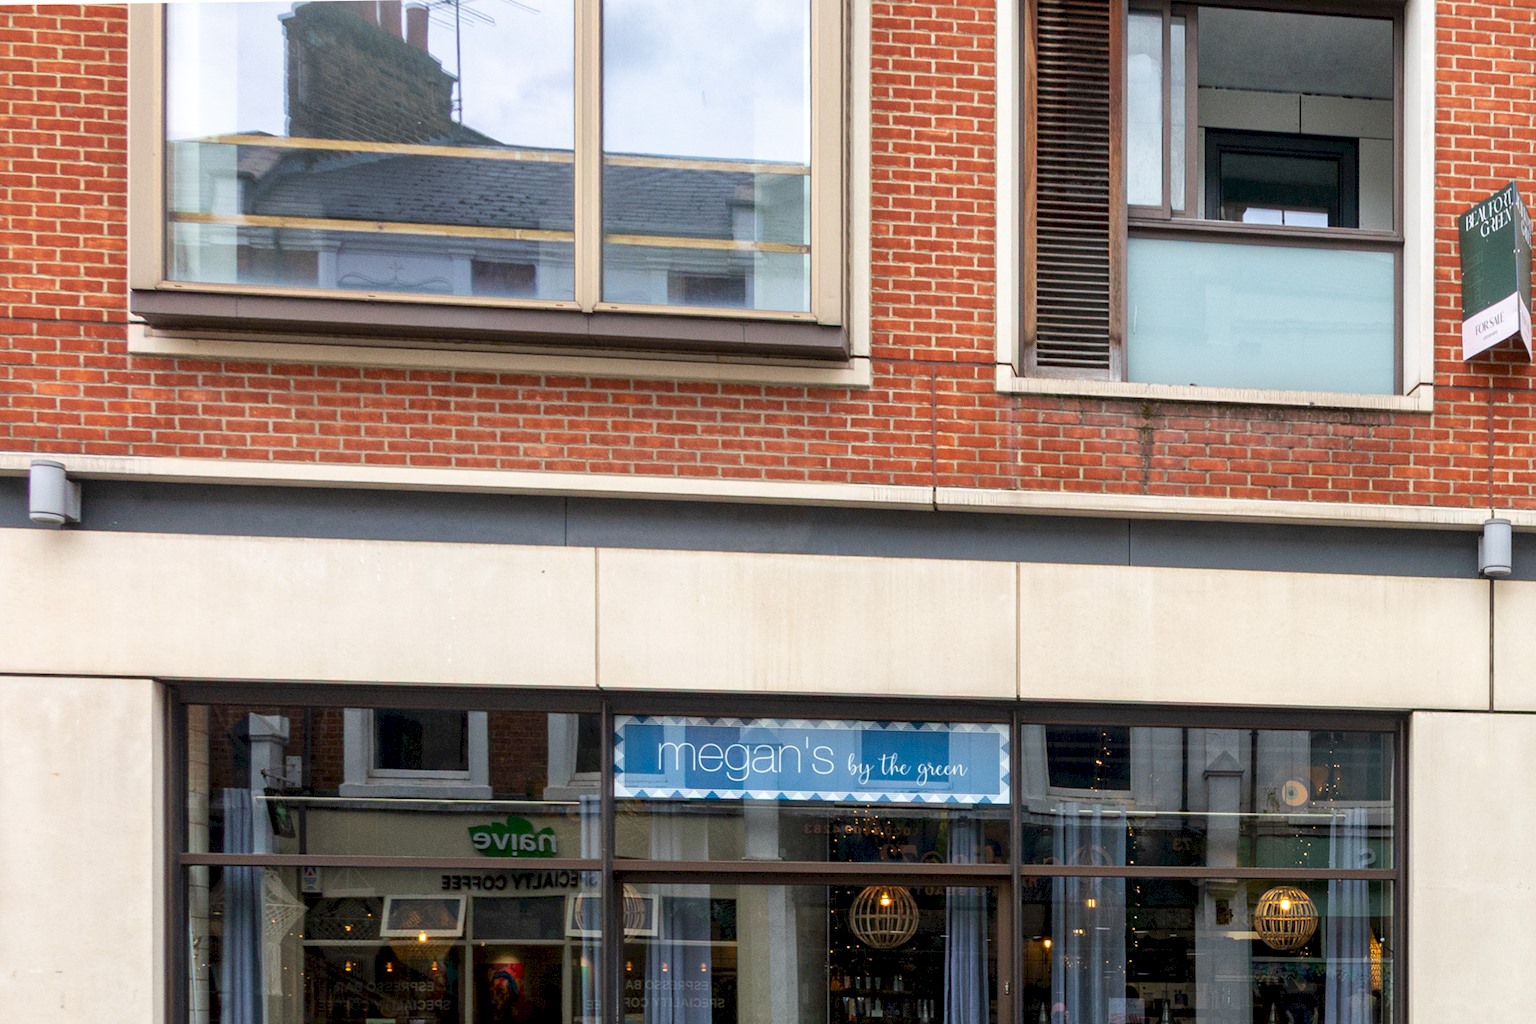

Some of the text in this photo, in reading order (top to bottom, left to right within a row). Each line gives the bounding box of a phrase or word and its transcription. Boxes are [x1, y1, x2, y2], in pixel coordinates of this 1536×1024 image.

[1465, 188, 1513, 231] BEAUFORT
[1480, 206, 1513, 238] GREEN
[1475, 320, 1489, 336] FOR
[1489, 311, 1505, 328] SALE
[657, 736, 969, 788] megan's by the green
